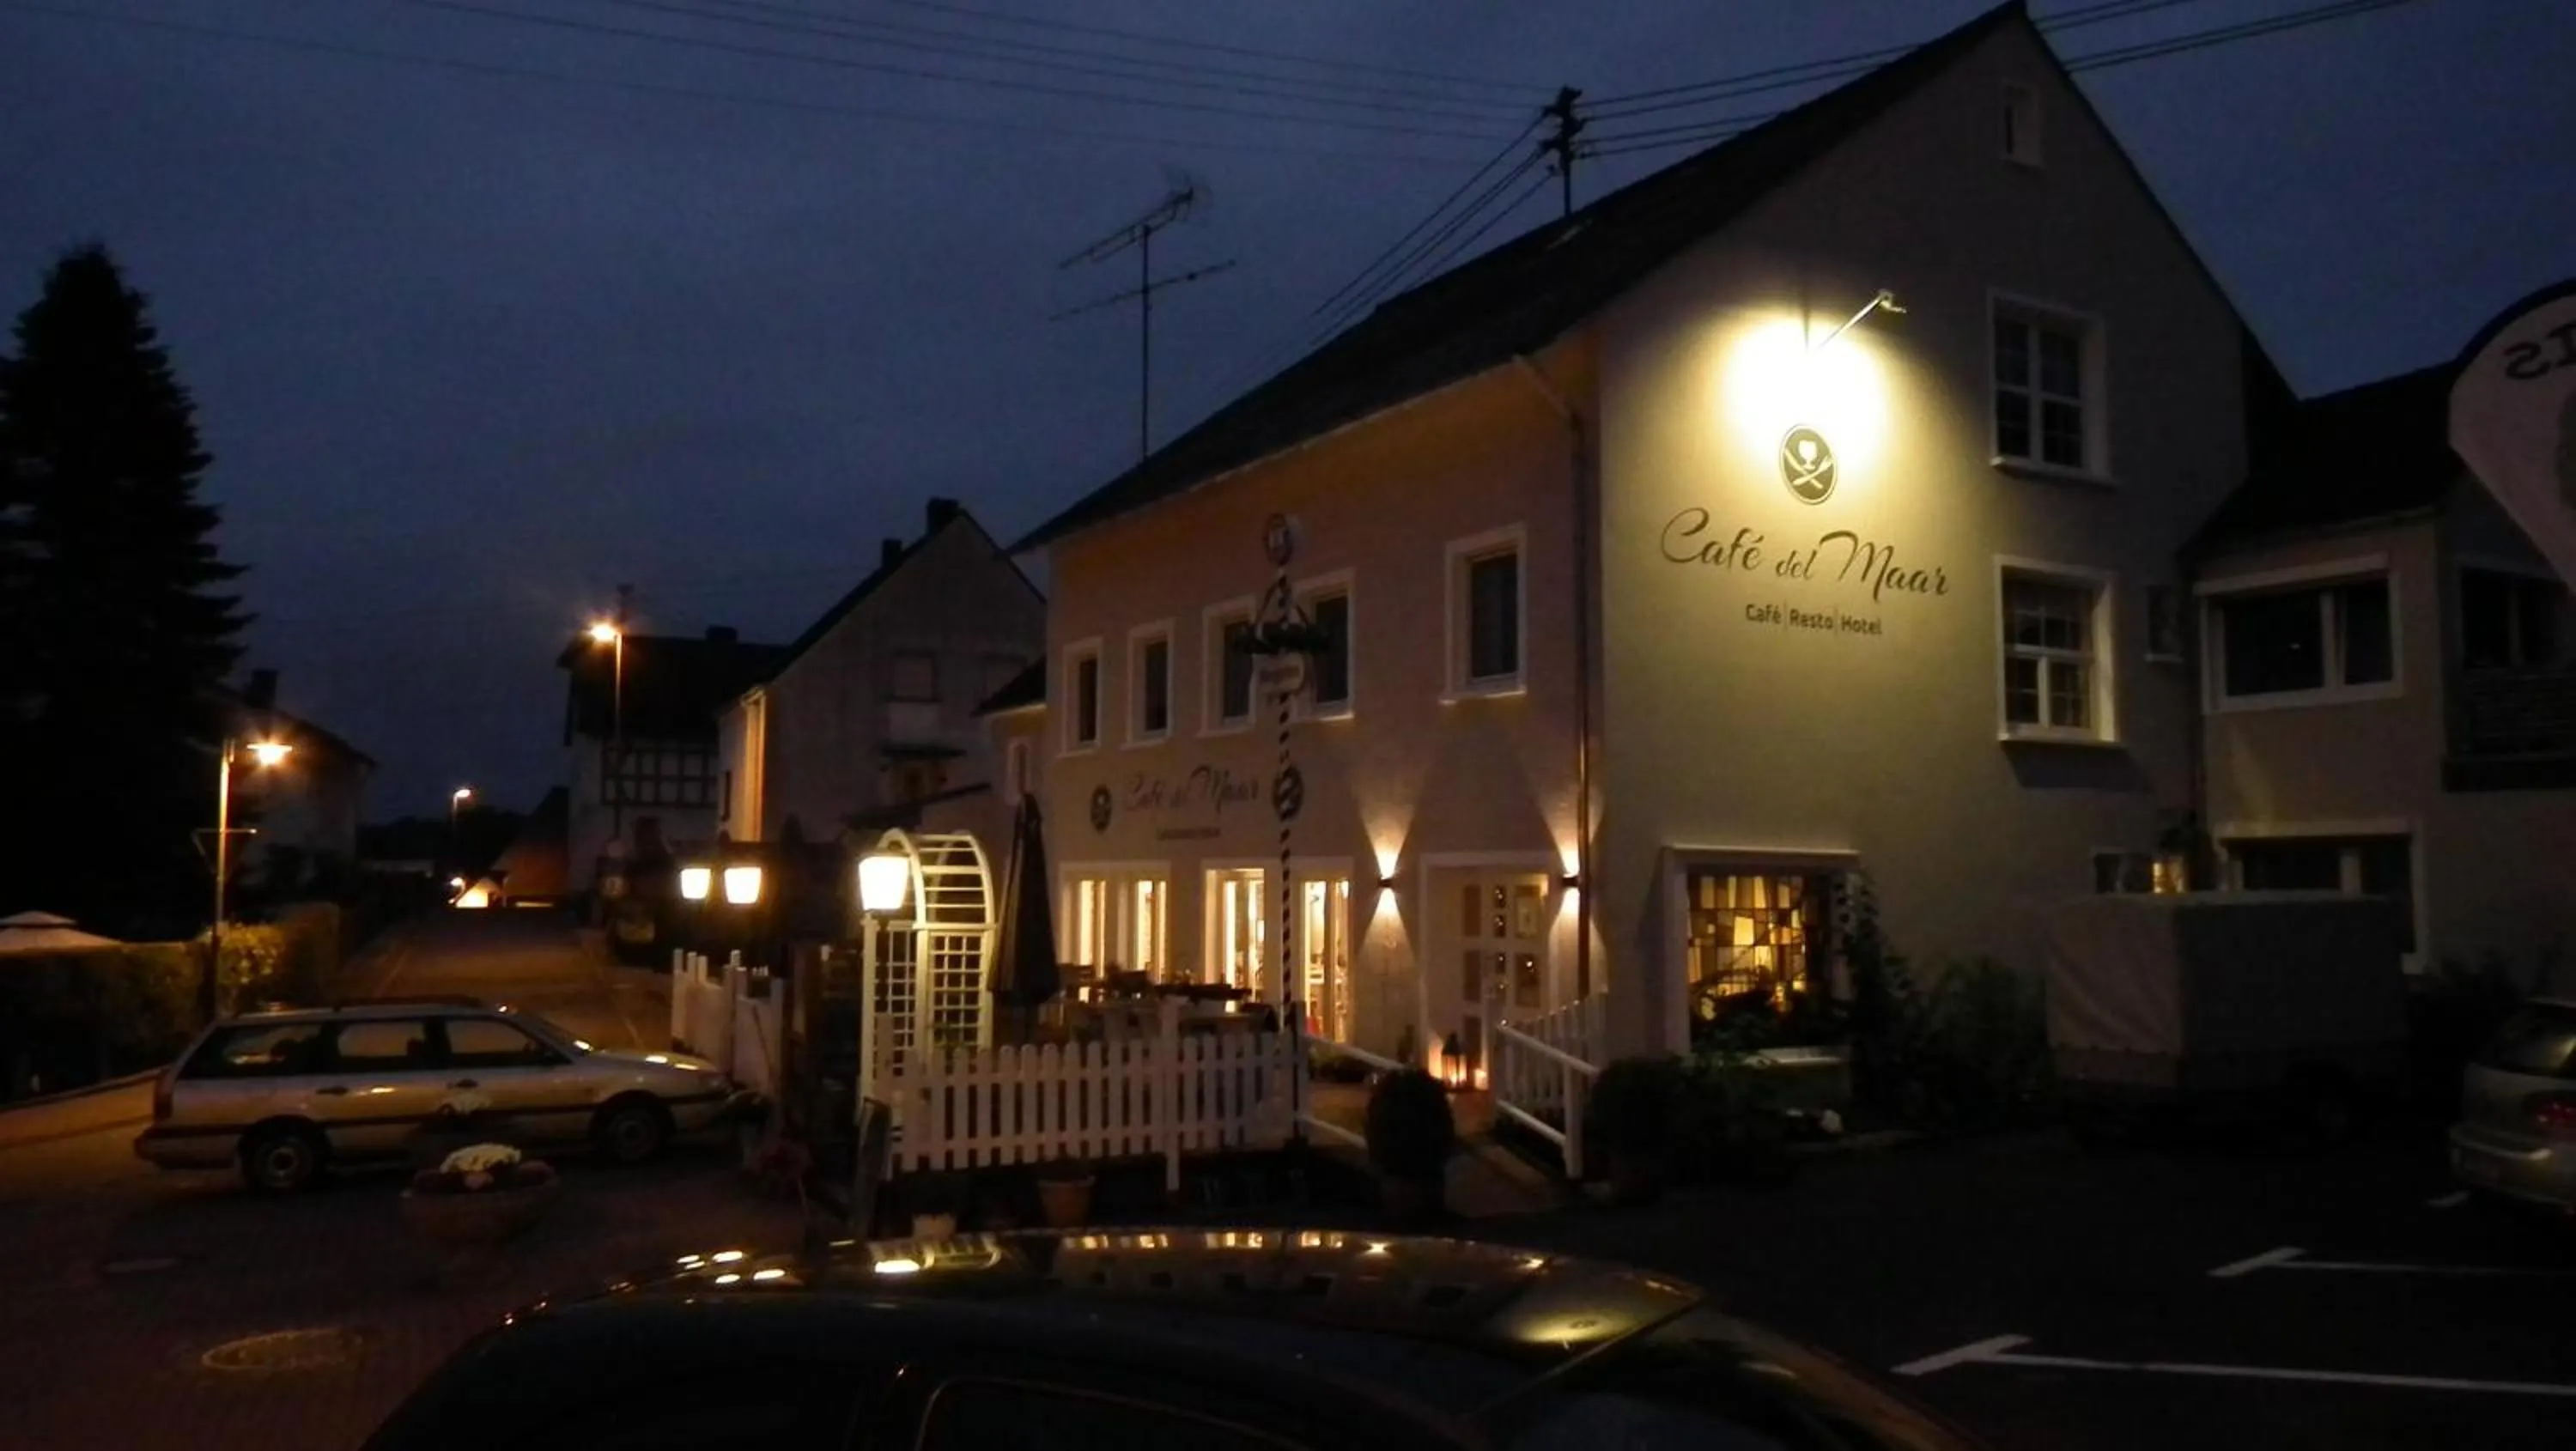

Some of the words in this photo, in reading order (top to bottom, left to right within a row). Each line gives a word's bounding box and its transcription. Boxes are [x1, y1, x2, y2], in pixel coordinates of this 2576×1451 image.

[1662, 507, 1765, 571] Café
[1775, 549, 1819, 580] del
[1819, 530, 1949, 603] Maar
[1746, 603, 1782, 625] Café
[1789, 608, 1833, 630] Resto
[1840, 612, 1883, 635] Hotel
